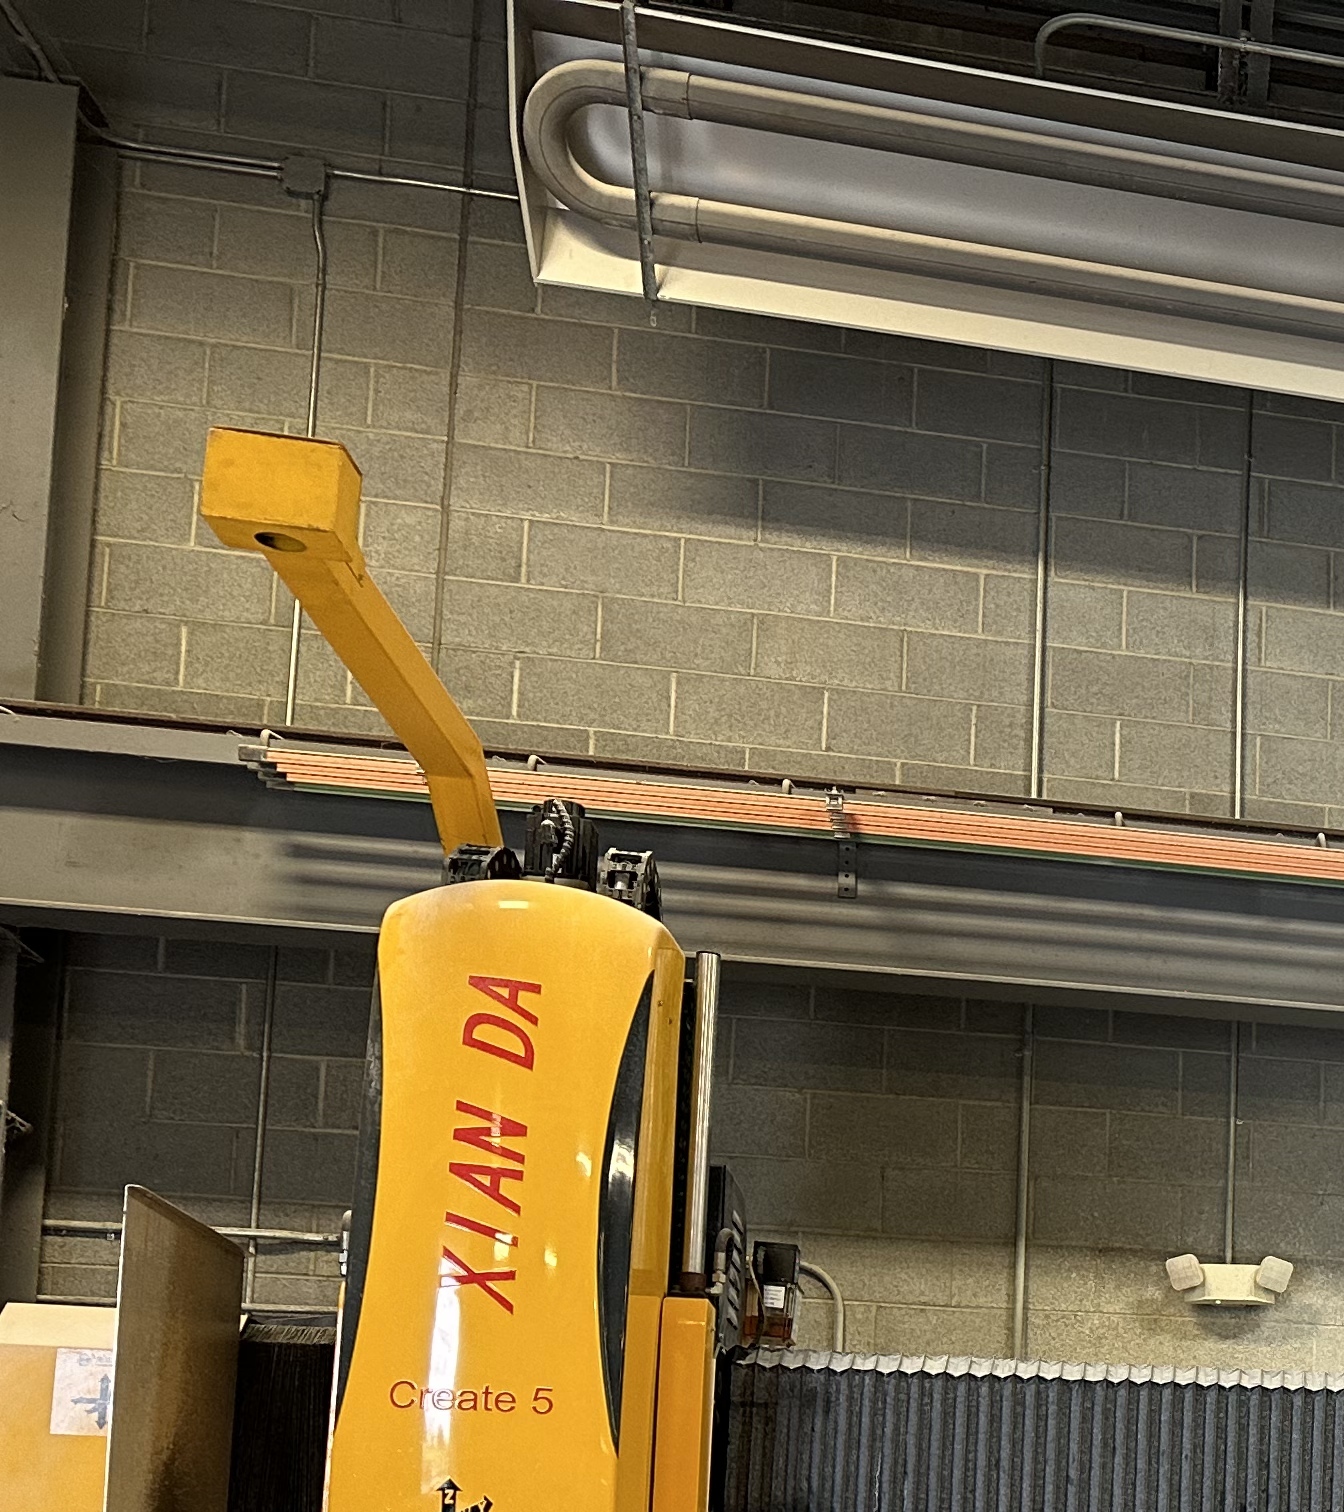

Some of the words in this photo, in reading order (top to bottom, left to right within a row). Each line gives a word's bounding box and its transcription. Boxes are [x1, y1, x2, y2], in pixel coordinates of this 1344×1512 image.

[462, 975, 542, 1072] DA
[440, 1100, 528, 1315] XIAN
[389, 1380, 517, 1413] Create
[531, 1387, 554, 1415] 5
